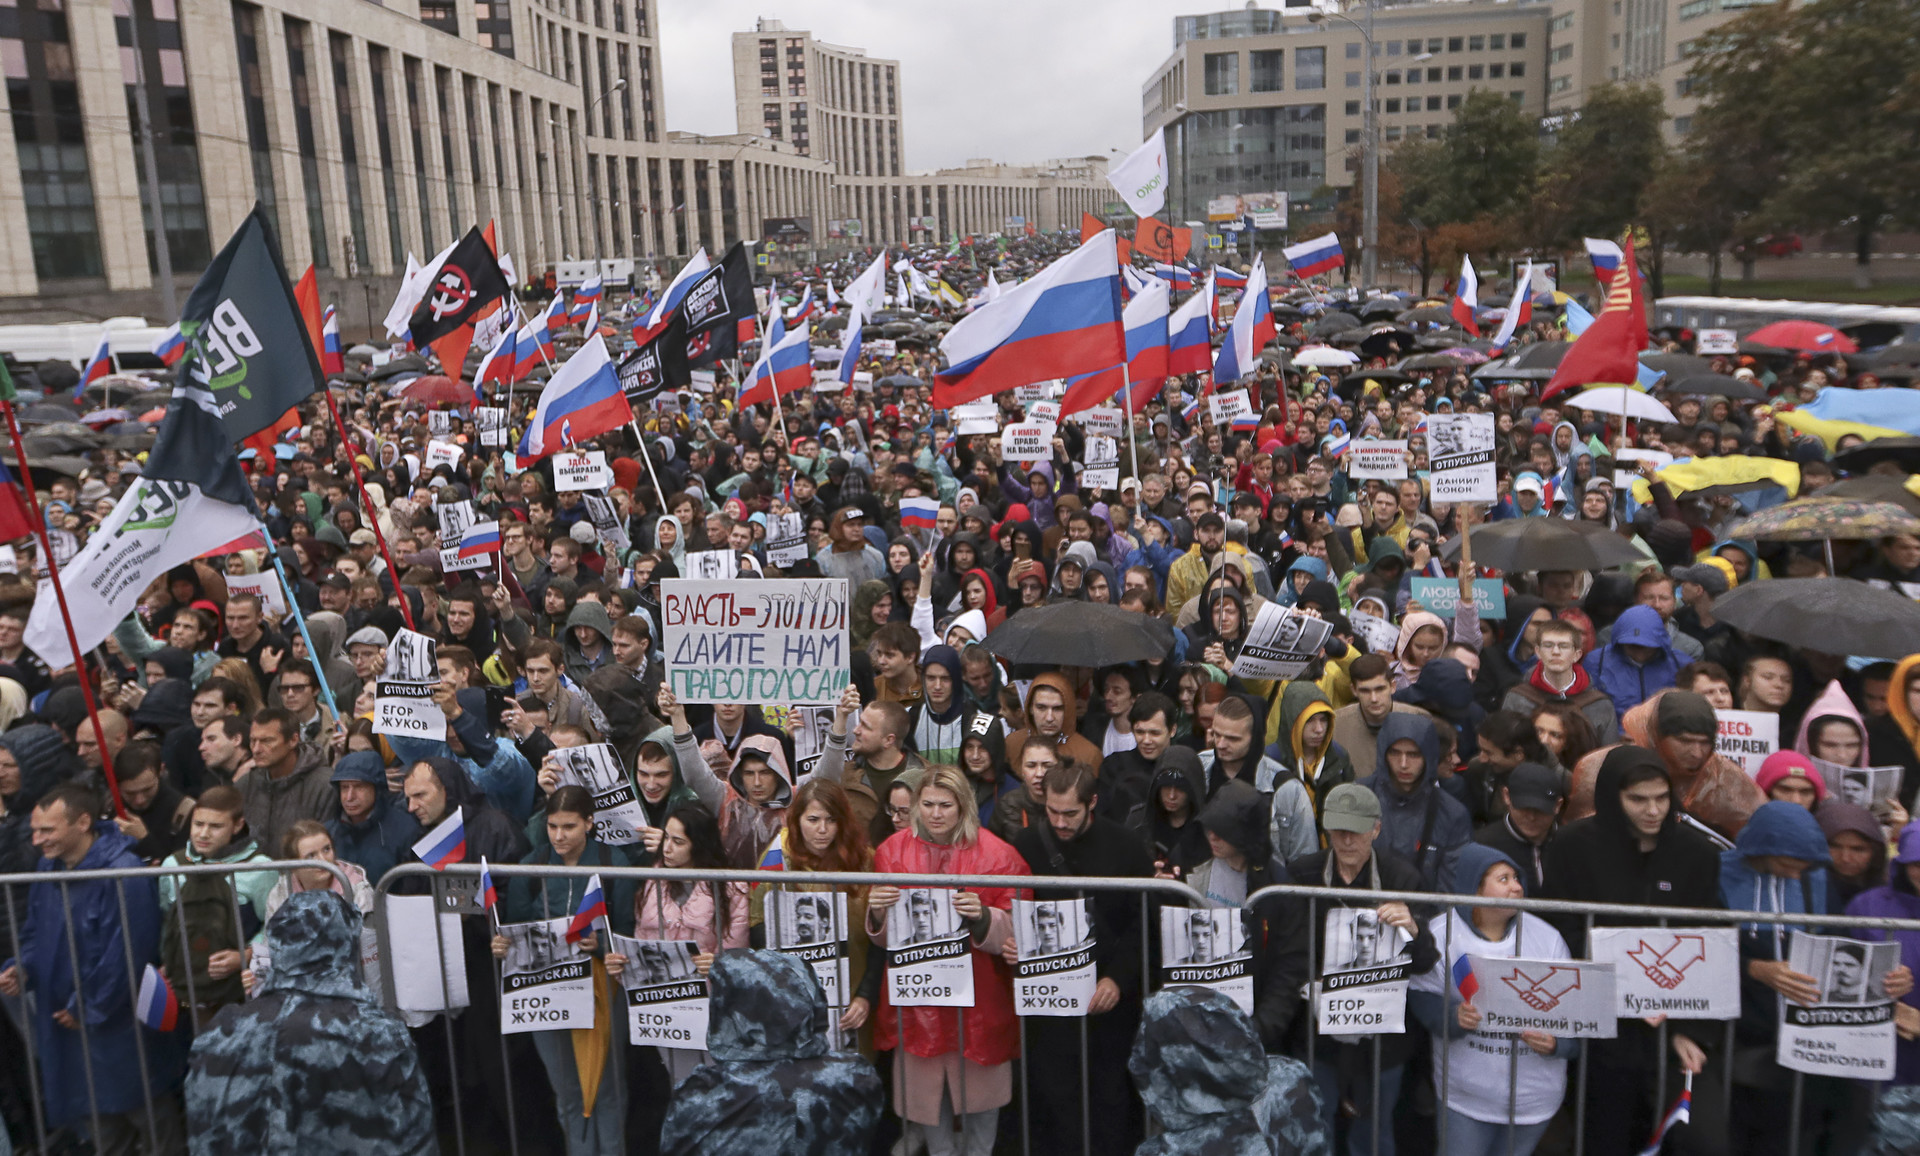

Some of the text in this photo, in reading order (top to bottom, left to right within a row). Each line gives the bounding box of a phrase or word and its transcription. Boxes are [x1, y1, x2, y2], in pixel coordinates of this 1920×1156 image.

[1006, 446, 1048, 454] НА ВЫБОР!
[568, 457, 591, 467] ЗДЕСЬ
[1436, 452, 1489, 470] ОТПУСКАЙ!
[559, 466, 601, 475] ВЫБИРАЕМ
[573, 475, 589, 483] МЫ!
[1436, 478, 1480, 486] ДАНИИЛ
[1436, 486, 1473, 494] КОНОН
[446, 557, 478, 568] ЖУКОВ
[671, 632, 840, 666] ДАЙТЕ НАМ
[1248, 648, 1308, 662] ОТПУСКАЙ!
[1241, 661, 1267, 672] ИВАН
[382, 704, 414, 717] ЕГОР
[381, 716, 429, 731] ЖУКОВ
[1716, 720, 1753, 737] ДЕСЬ
[1713, 738, 1770, 755] БИРАЕМ
[595, 819, 613, 831] ОР
[596, 828, 632, 842] УКОВ
[894, 942, 964, 965] ОТПУСКАЙ!
[1020, 952, 1090, 975] ОТПУСКАЙ!
[511, 965, 584, 988] ОТПУСКАЙ!
[1171, 963, 1244, 980] ОТПУСКАЙ!
[1329, 968, 1404, 988] ОТПУСКАЙ!
[896, 974, 933, 986] ЕГОР
[636, 984, 701, 1002] ОТПУСКАЙ!
[896, 986, 952, 998] ЖУКОВ
[1022, 985, 1059, 996] ЕГОР
[512, 997, 551, 1010] ЕГОР
[1022, 998, 1079, 1008] ЖУКОВ
[1328, 999, 1366, 1012] ЕГОР
[1624, 993, 1710, 1014] Кузьминки
[512, 1010, 570, 1024] ЖУКОВ
[638, 1013, 673, 1026] ЕГОР
[1327, 1013, 1383, 1026] ЖУКОВ
[1487, 1012, 1599, 1034] Рязанский р-н
[638, 1026, 691, 1040] ЖУКОВ
[1794, 1037, 1837, 1052] ИВАН
[1792, 1049, 1887, 1069] ПОДКОПАЕВ
